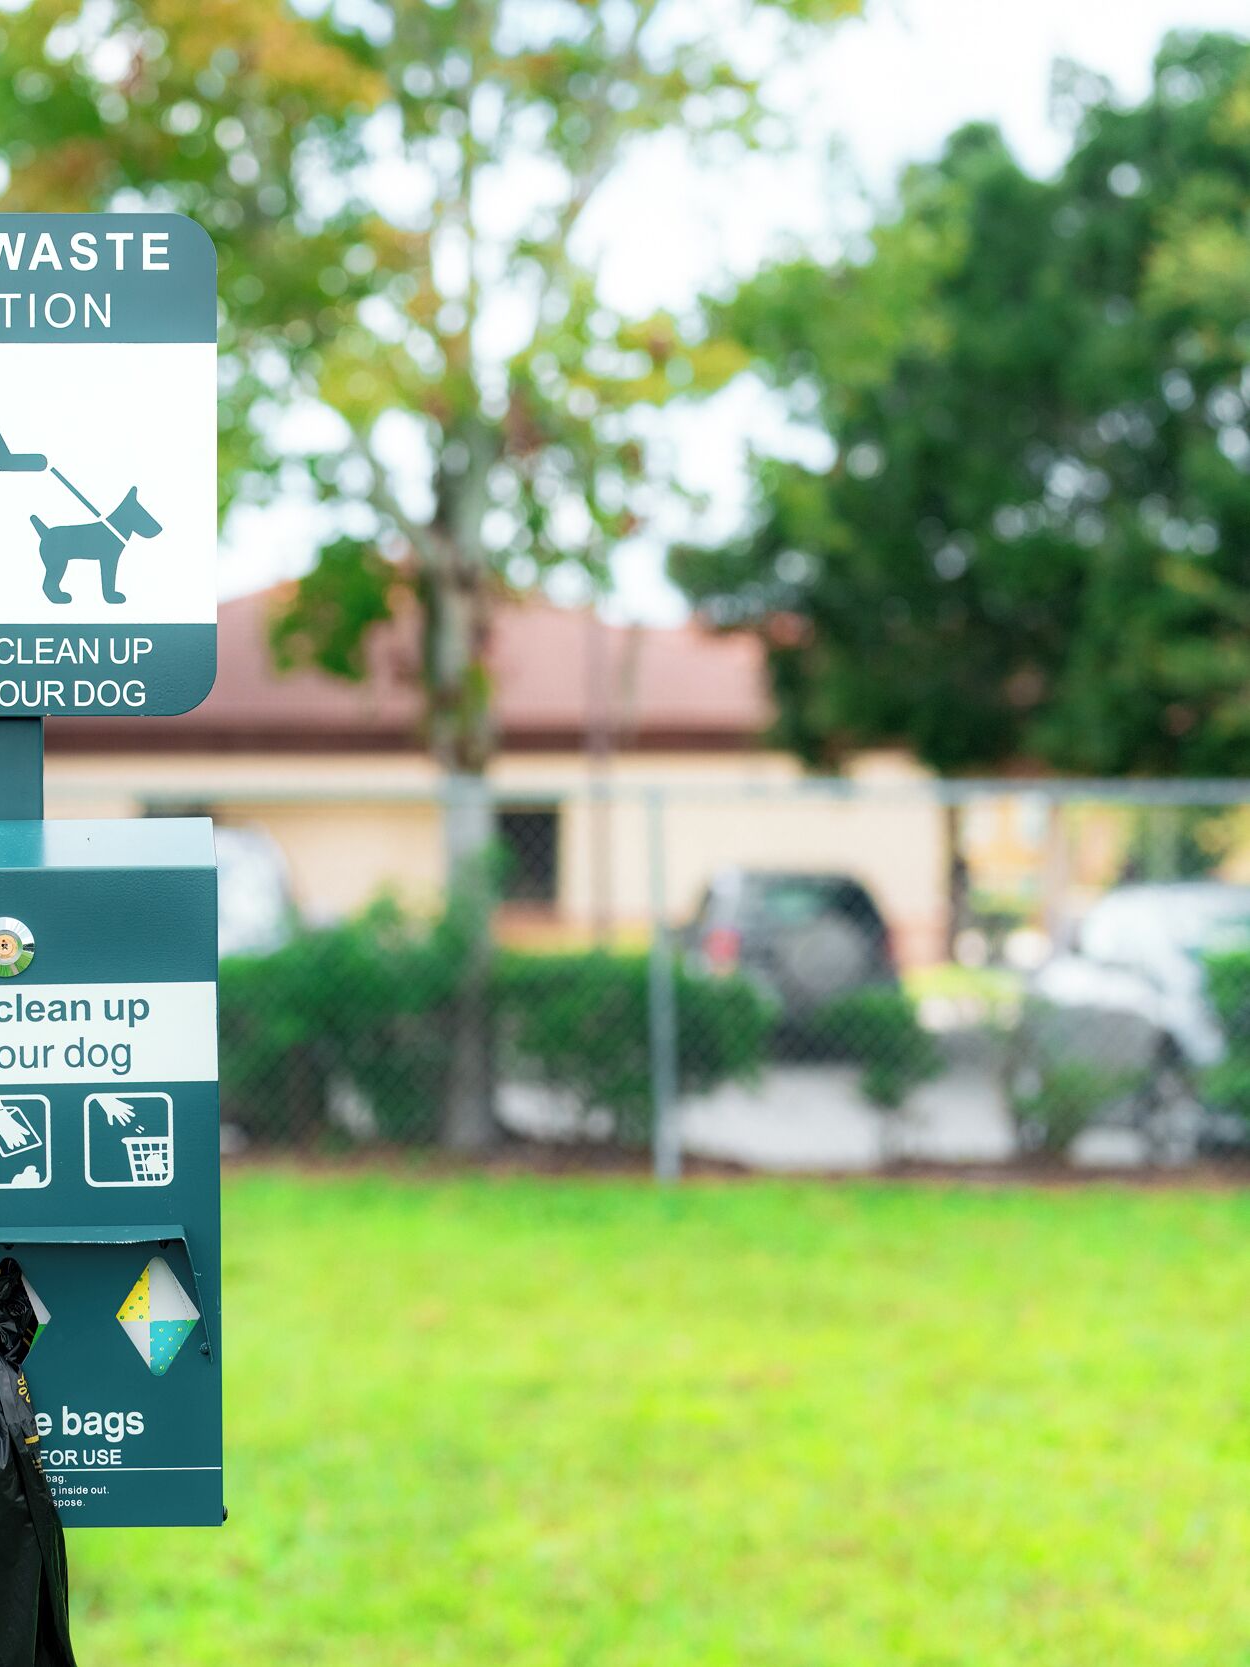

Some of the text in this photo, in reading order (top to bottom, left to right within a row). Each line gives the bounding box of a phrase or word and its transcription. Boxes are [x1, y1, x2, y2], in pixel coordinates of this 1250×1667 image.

[109, 637, 153, 665] UP
[74, 679, 146, 707] DOG
[103, 998, 150, 1028] up
[64, 1036, 132, 1076] dog
[62, 1405, 145, 1443] bags
[82, 1448, 122, 1466] USE
[58, 1485, 89, 1495] inside
[90, 1485, 110, 1495] out.
